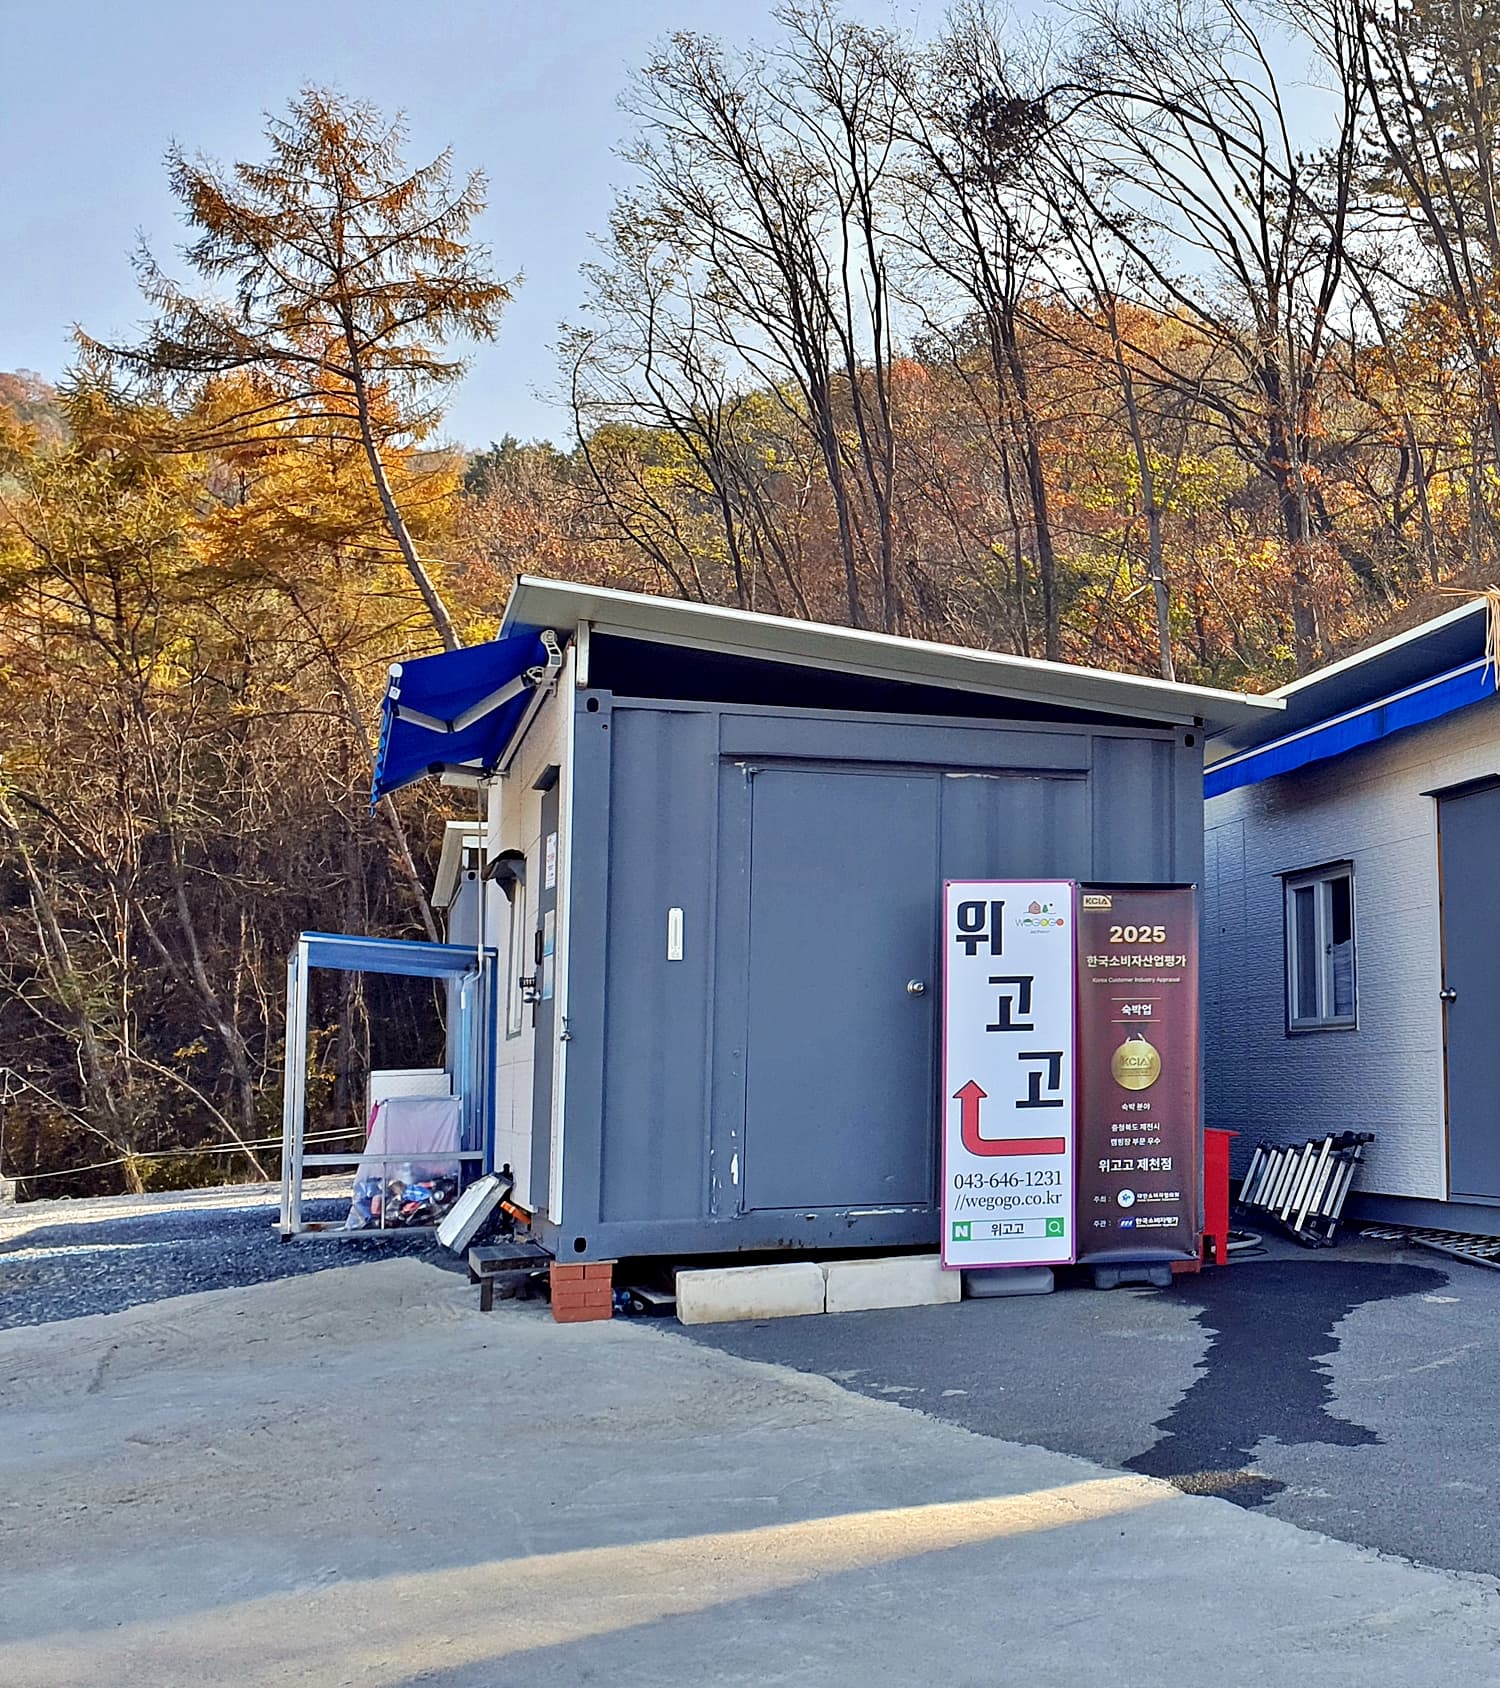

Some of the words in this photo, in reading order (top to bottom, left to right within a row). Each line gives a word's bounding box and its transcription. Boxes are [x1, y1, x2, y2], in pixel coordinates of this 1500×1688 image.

[1085, 897, 1108, 905] KCIA
[1110, 925, 1166, 943] 2025
[1086, 955, 1187, 968] 한국소비자산업평가
[1121, 1004, 1152, 1016] 숙박업
[1098, 1159, 1134, 1173] 위고고
[1136, 1157, 1172, 1171] 제천점
[954, 1170, 1062, 1189] 043-646-1231
[955, 1190, 1062, 1211] //wegogo.co.kr
[991, 1223, 1025, 1236] 위고고
